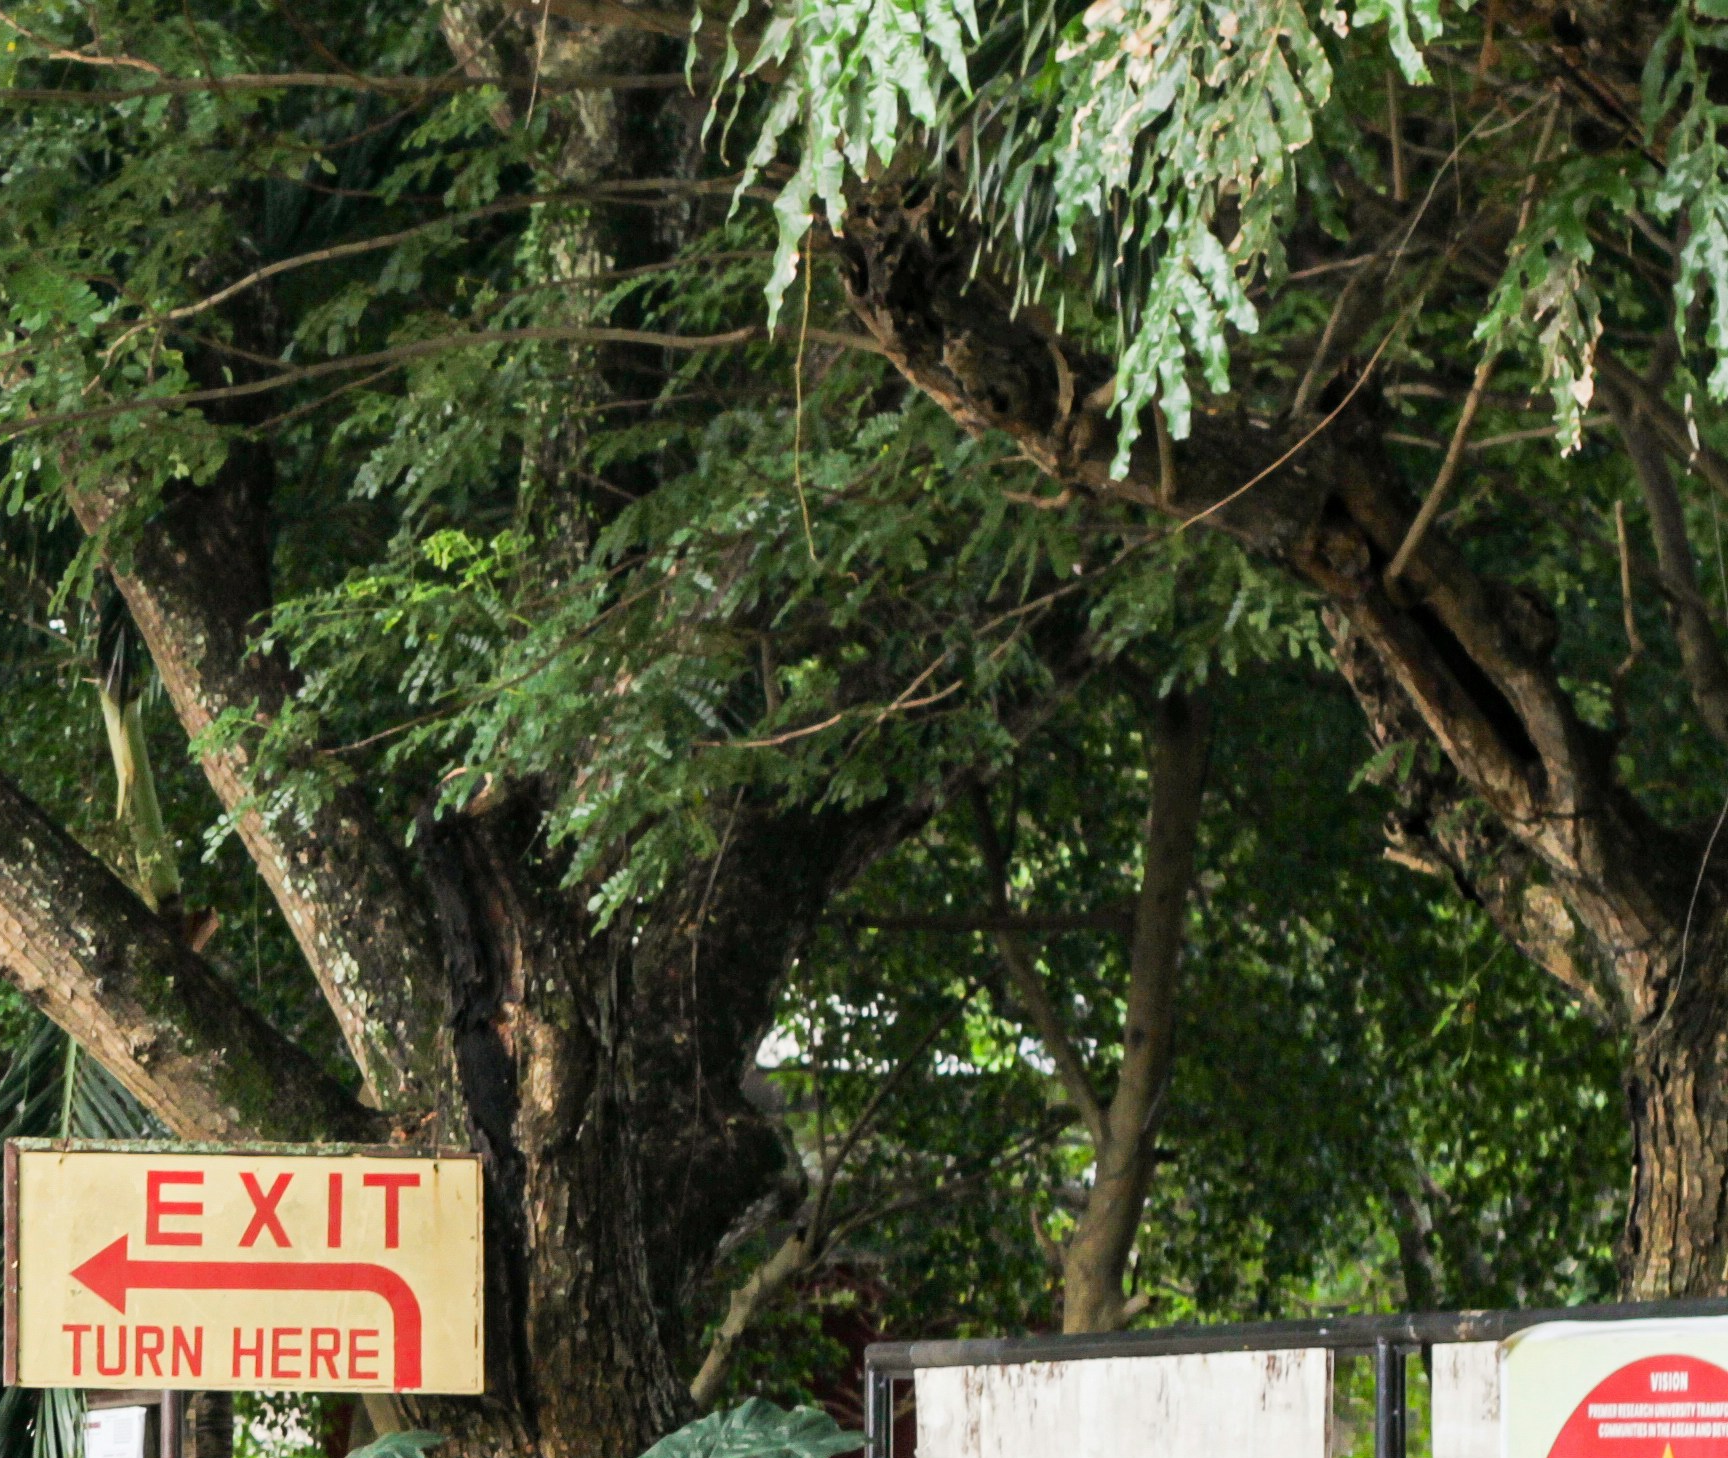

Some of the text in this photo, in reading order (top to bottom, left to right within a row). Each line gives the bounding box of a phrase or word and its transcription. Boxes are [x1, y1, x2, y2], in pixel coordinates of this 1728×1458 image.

[145, 1170, 421, 1250] EXIT
[61, 1323, 380, 1381] TURN HERE
[1650, 1371, 1689, 1393] VISION
[1618, 1403, 1654, 1418] RESEARCH
[1655, 1402, 1695, 1418] UNIVERSITY
[1598, 1422, 1647, 1438] COMMUNITIES
[1657, 1422, 1671, 1438] THE
[1671, 1422, 1695, 1438] ASEAN
[1696, 1422, 1712, 1438] AND
